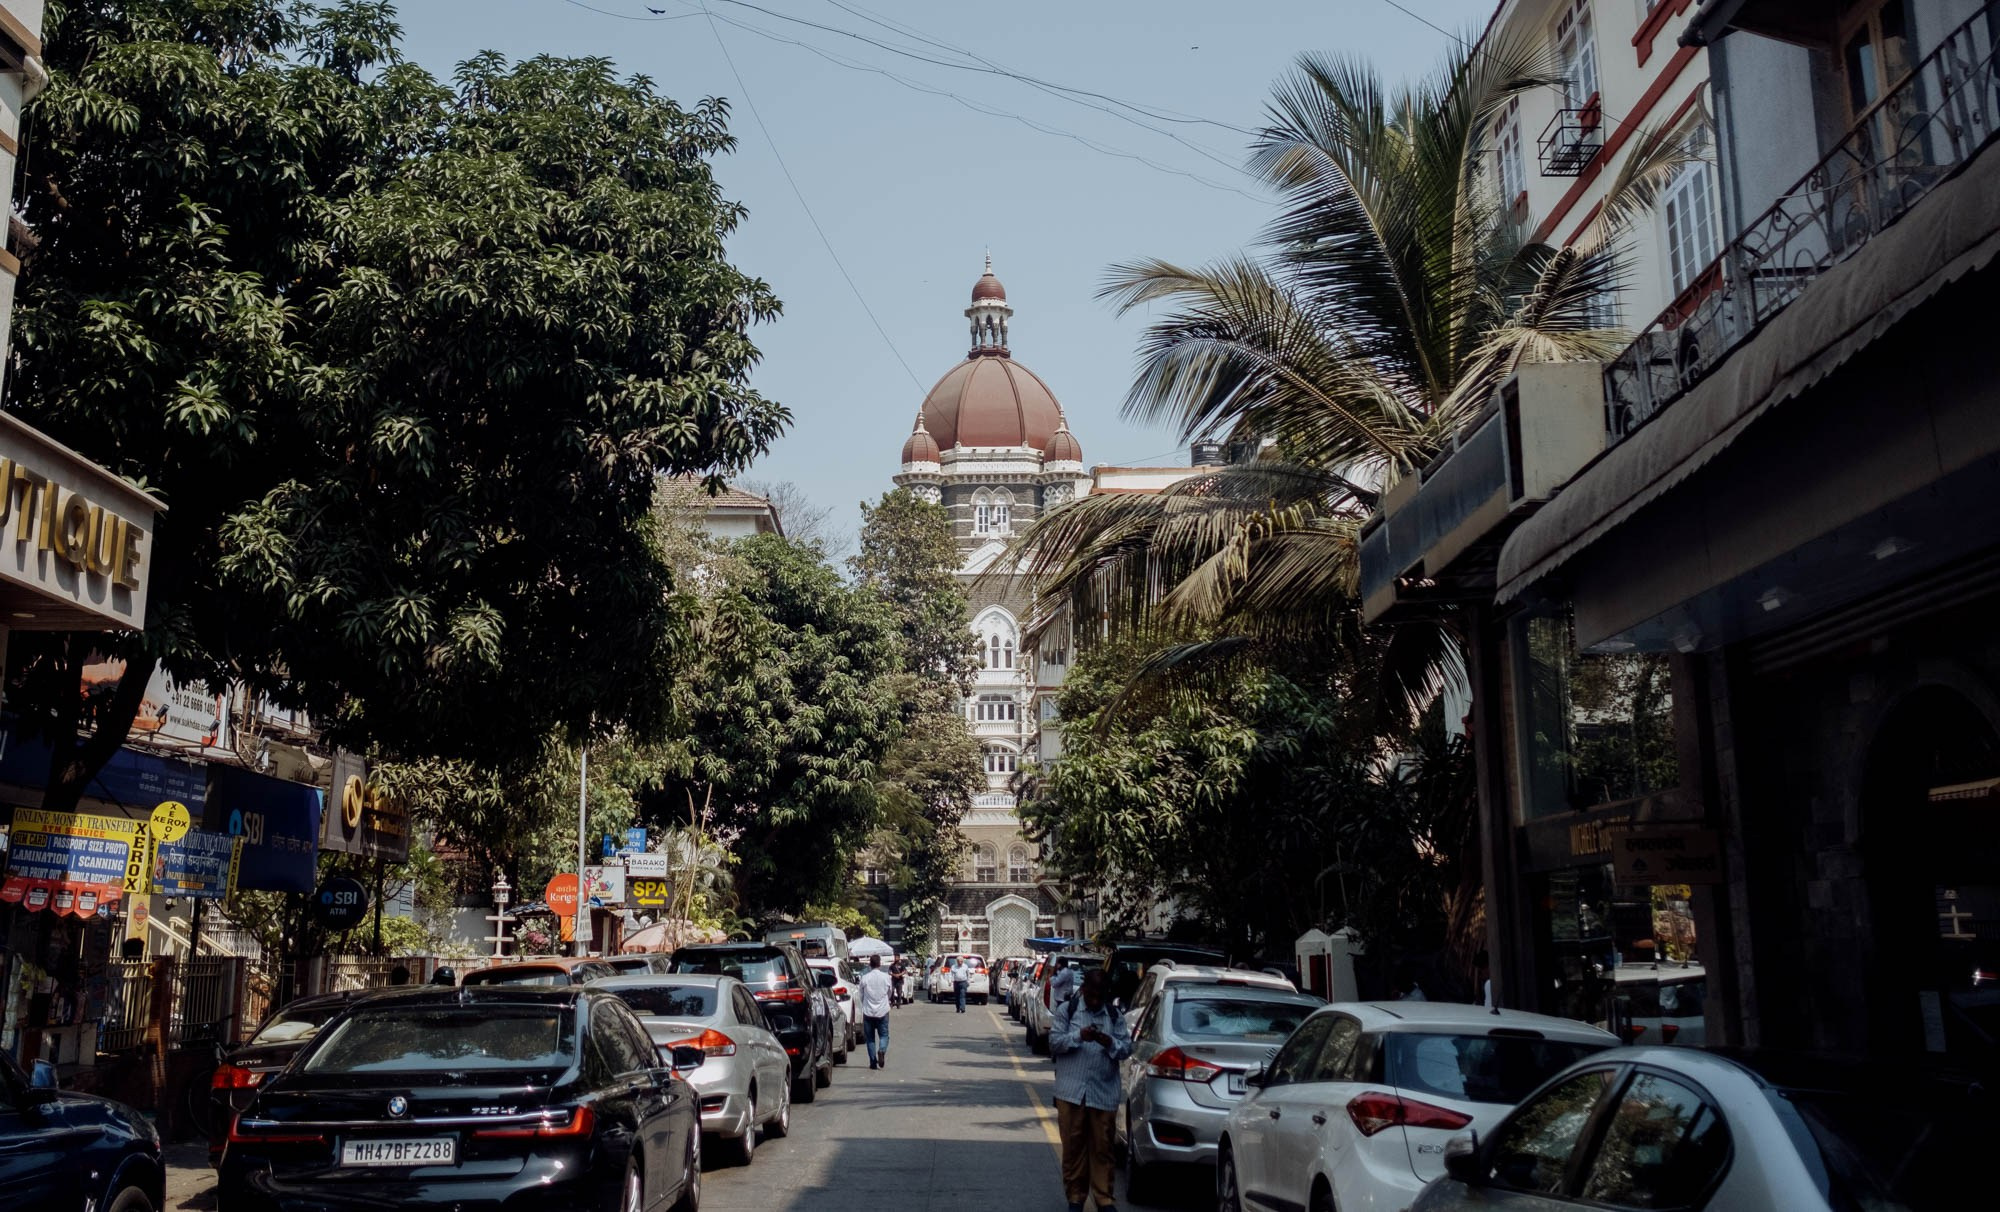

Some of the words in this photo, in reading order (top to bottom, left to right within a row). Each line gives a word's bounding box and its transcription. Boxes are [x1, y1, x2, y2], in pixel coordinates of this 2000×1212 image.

[183, 695, 190, 708] 22
[15, 809, 49, 825] ONLINE
[51, 812, 84, 828] MONEY
[87, 816, 134, 833] TRANSFER
[153, 815, 188, 828] XEROX
[163, 803, 177, 840] XEROX
[243, 811, 265, 845] SBI
[42, 825, 61, 834] ATM
[65, 826, 105, 838] SERVICE
[15, 833, 27, 844] SIM
[29, 834, 47, 846] CARD
[53, 837, 88, 851] PASSPORT
[88, 840, 104, 853] SIZE
[104, 842, 128, 855] PHOTO
[12, 849, 69, 865] LAMINATION
[78, 856, 124, 871] SCANNING
[125, 822, 147, 891] XEROX
[631, 859, 665, 867] BARAKO
[29, 867, 48, 879] PRINT
[49, 869, 62, 880] OUT
[144, 836, 157, 896] EROX
[335, 891, 358, 905] SBI
[633, 881, 669, 897] SPA
[329, 907, 347, 916] ATM
[354, 1141, 452, 1161] MH47BF2288
